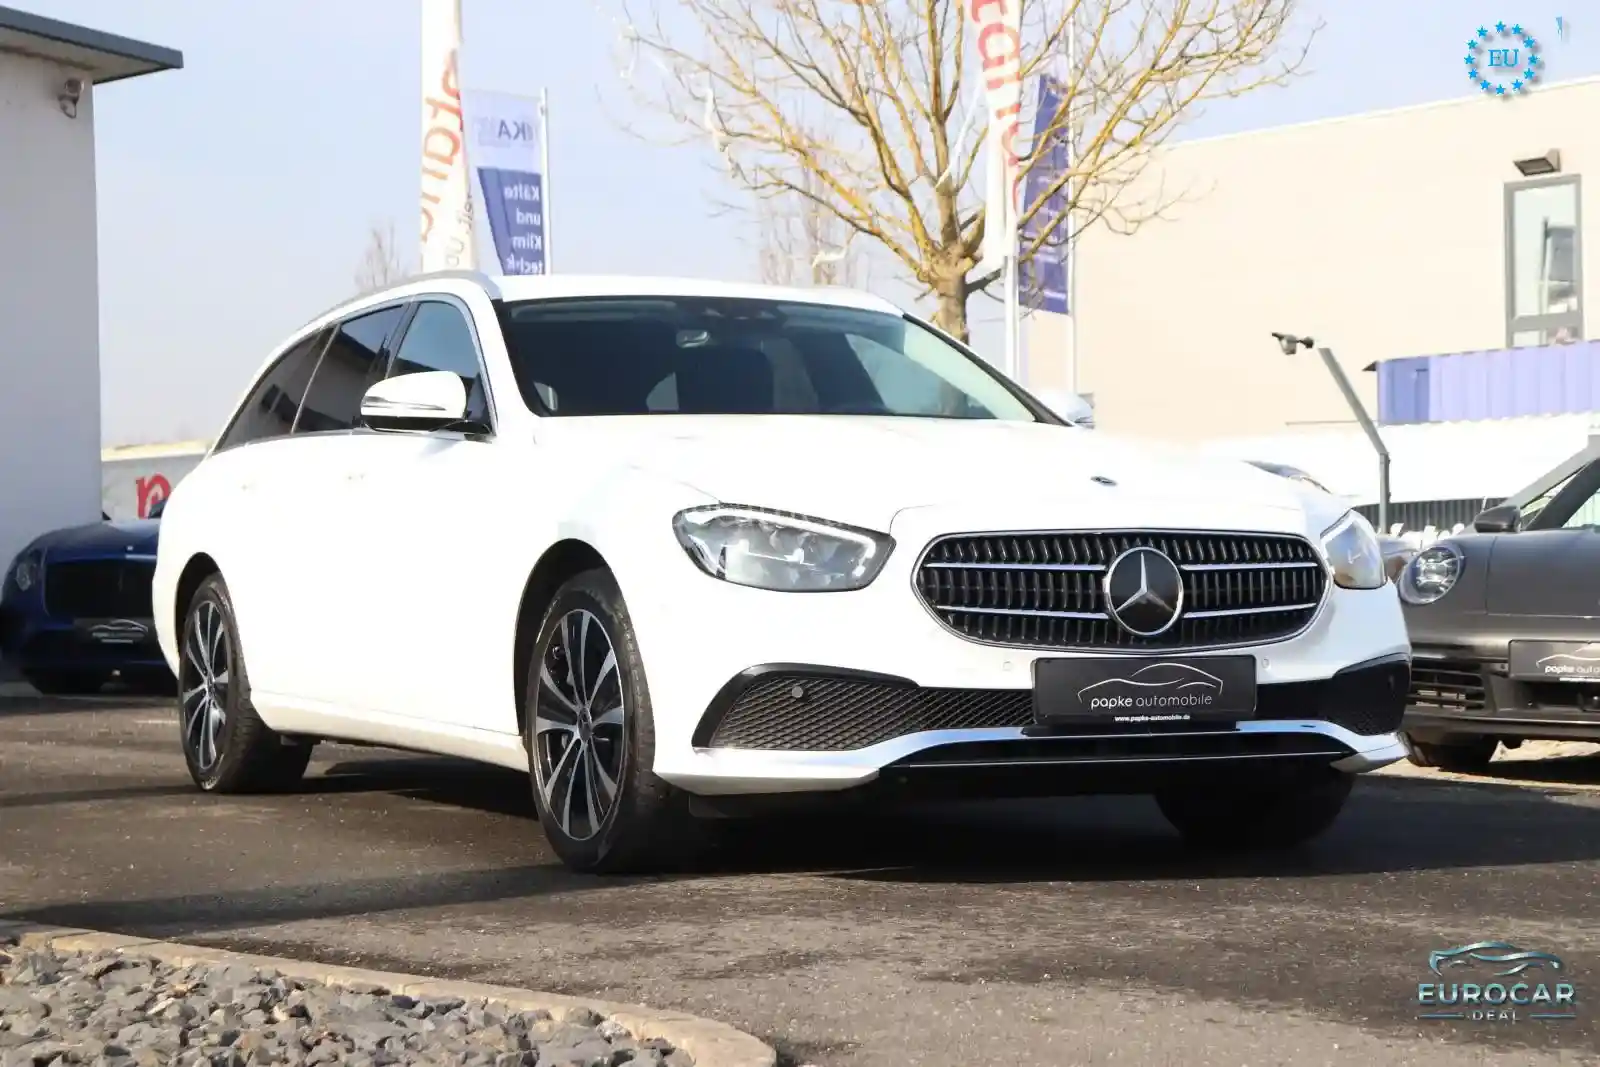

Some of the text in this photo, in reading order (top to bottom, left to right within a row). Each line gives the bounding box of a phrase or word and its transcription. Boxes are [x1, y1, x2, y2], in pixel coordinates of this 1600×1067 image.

[1091, 694, 1212, 710] papke automobile
[1114, 714, 1190, 723] www.papke-automobile.de
